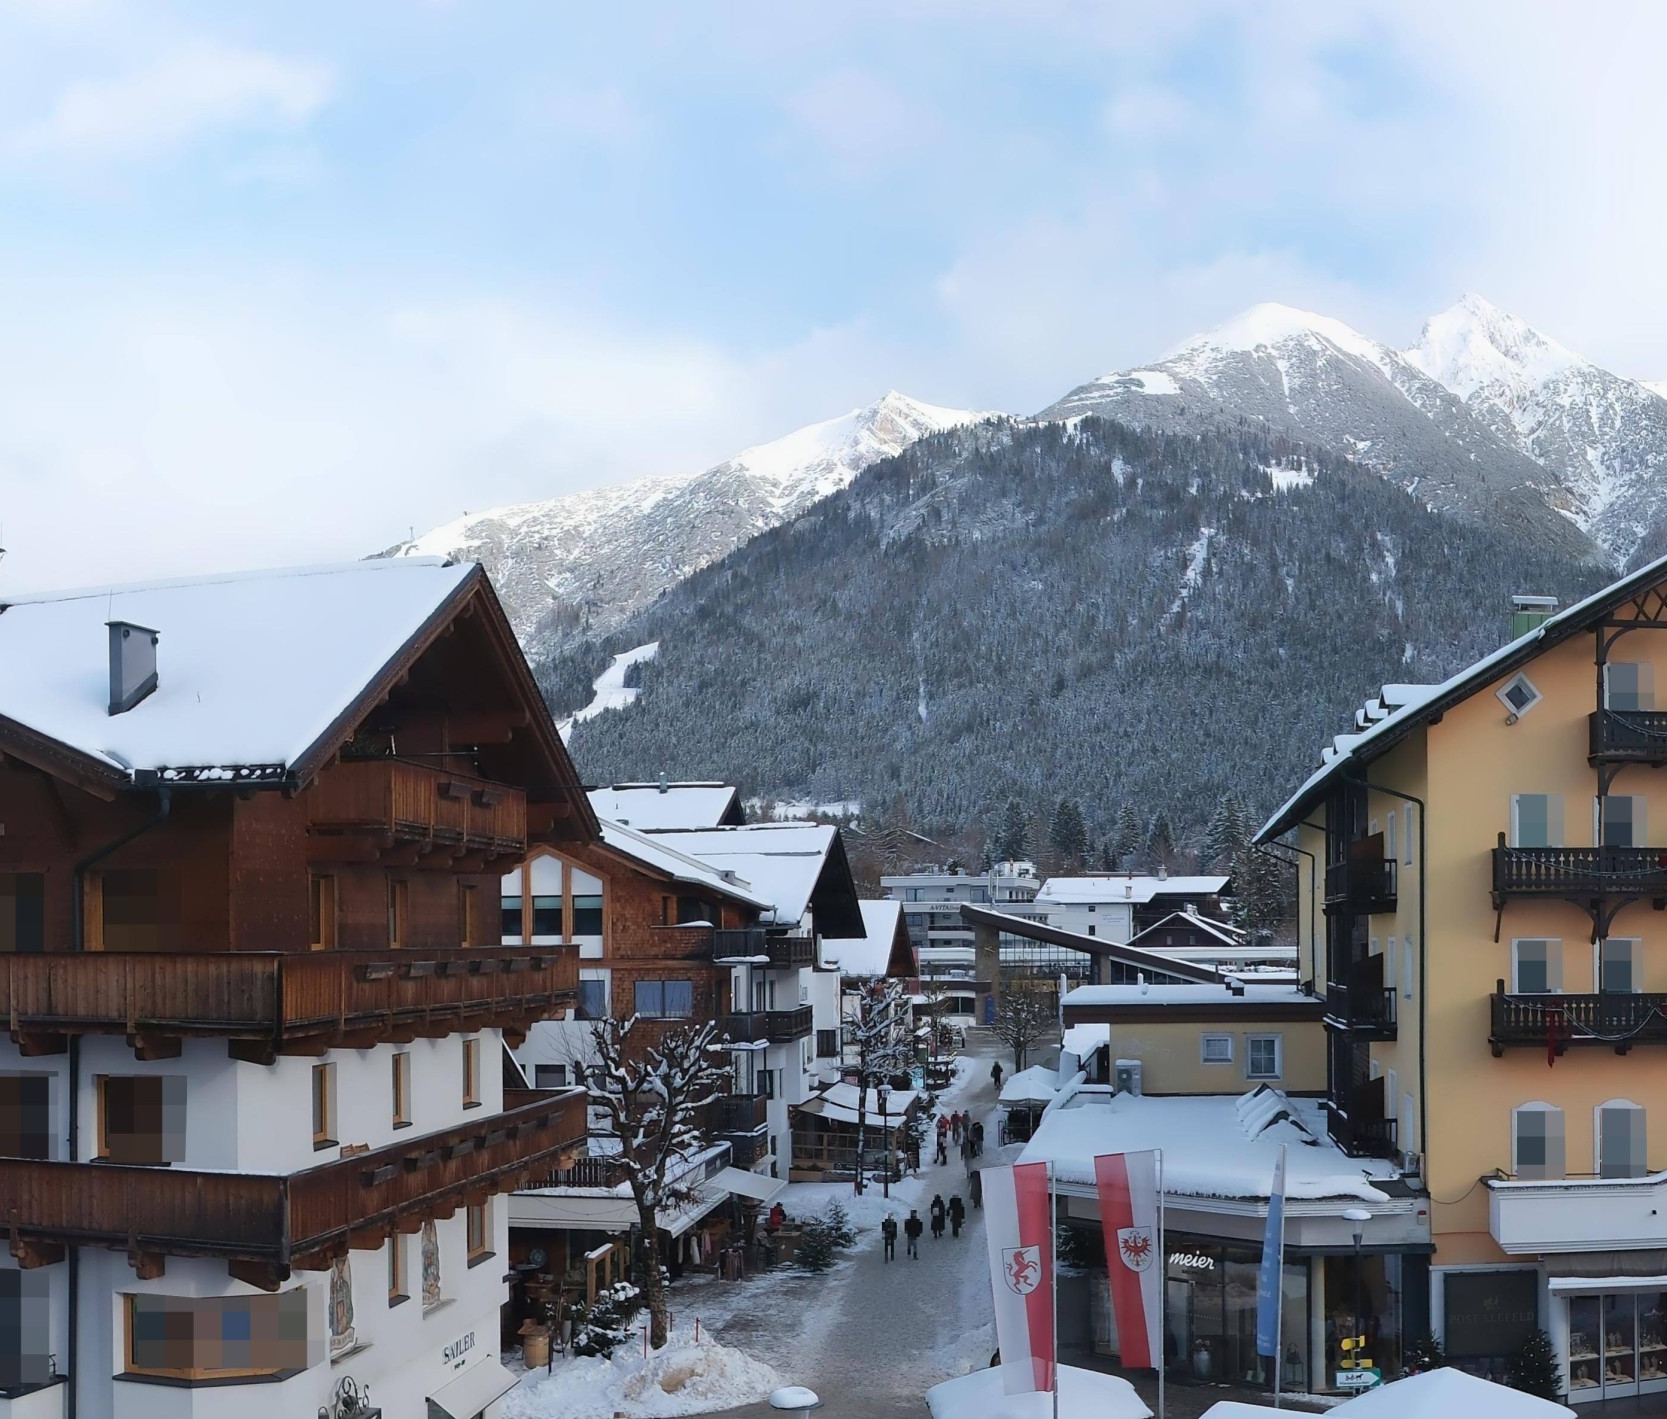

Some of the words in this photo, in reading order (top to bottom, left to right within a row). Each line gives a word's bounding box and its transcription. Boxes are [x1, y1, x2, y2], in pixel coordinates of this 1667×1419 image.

[1169, 1250, 1215, 1270] meier
[1450, 1313, 1478, 1324] POST
[442, 1331, 475, 1365] SAILER
